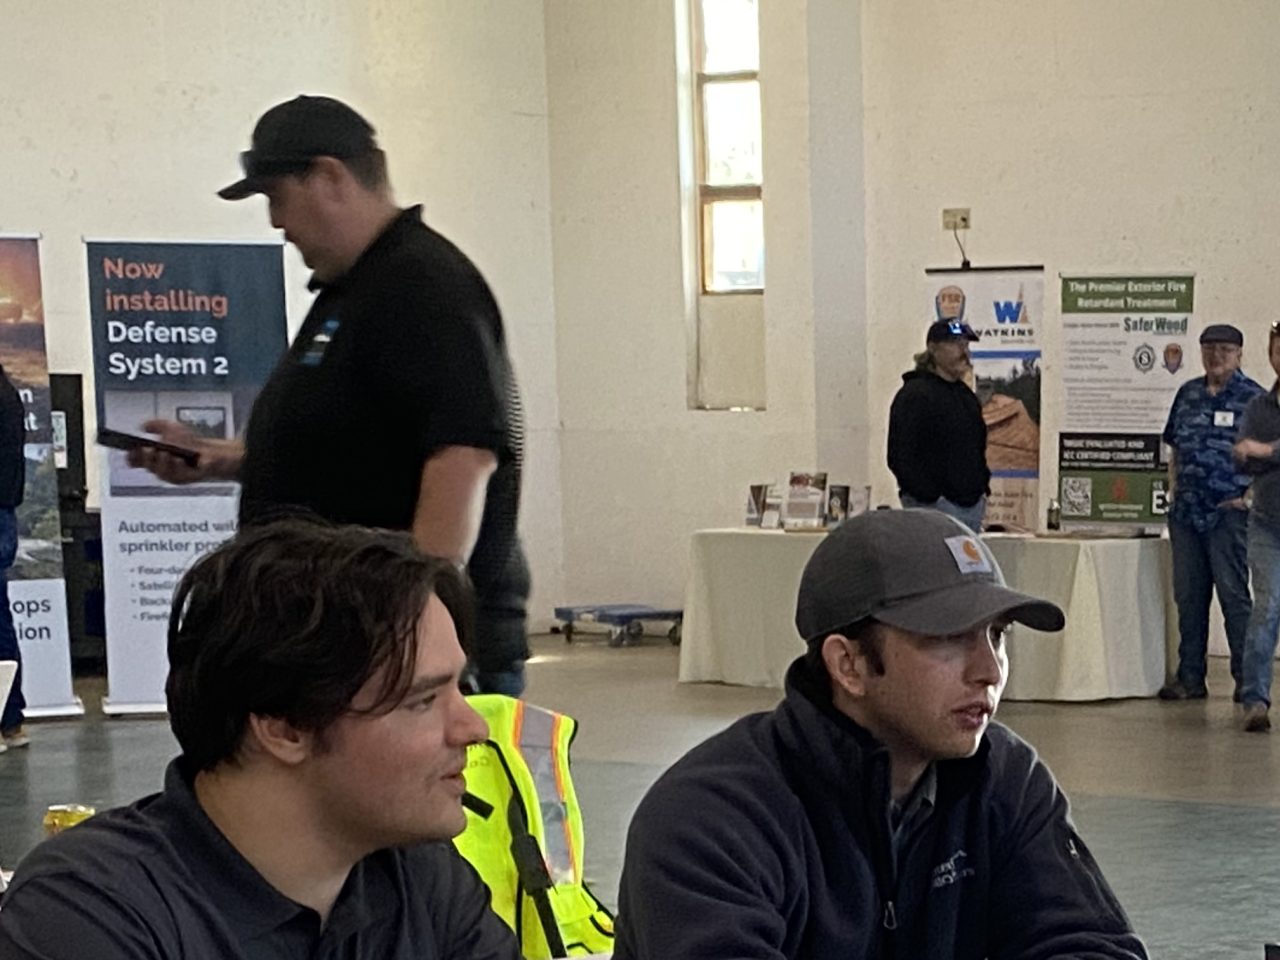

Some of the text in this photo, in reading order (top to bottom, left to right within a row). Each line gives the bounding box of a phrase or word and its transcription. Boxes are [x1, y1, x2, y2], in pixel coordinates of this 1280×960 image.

[103, 257, 165, 279] Now
[1069, 281, 1186, 293] The Premier Exterior Fire
[105, 288, 228, 318] installing
[1077, 297, 1177, 308] Retardant Treatment
[107, 320, 217, 343] Defense
[108, 352, 229, 380] System 2
[118, 521, 208, 534] Automated
[119, 539, 191, 555] sprinkler
